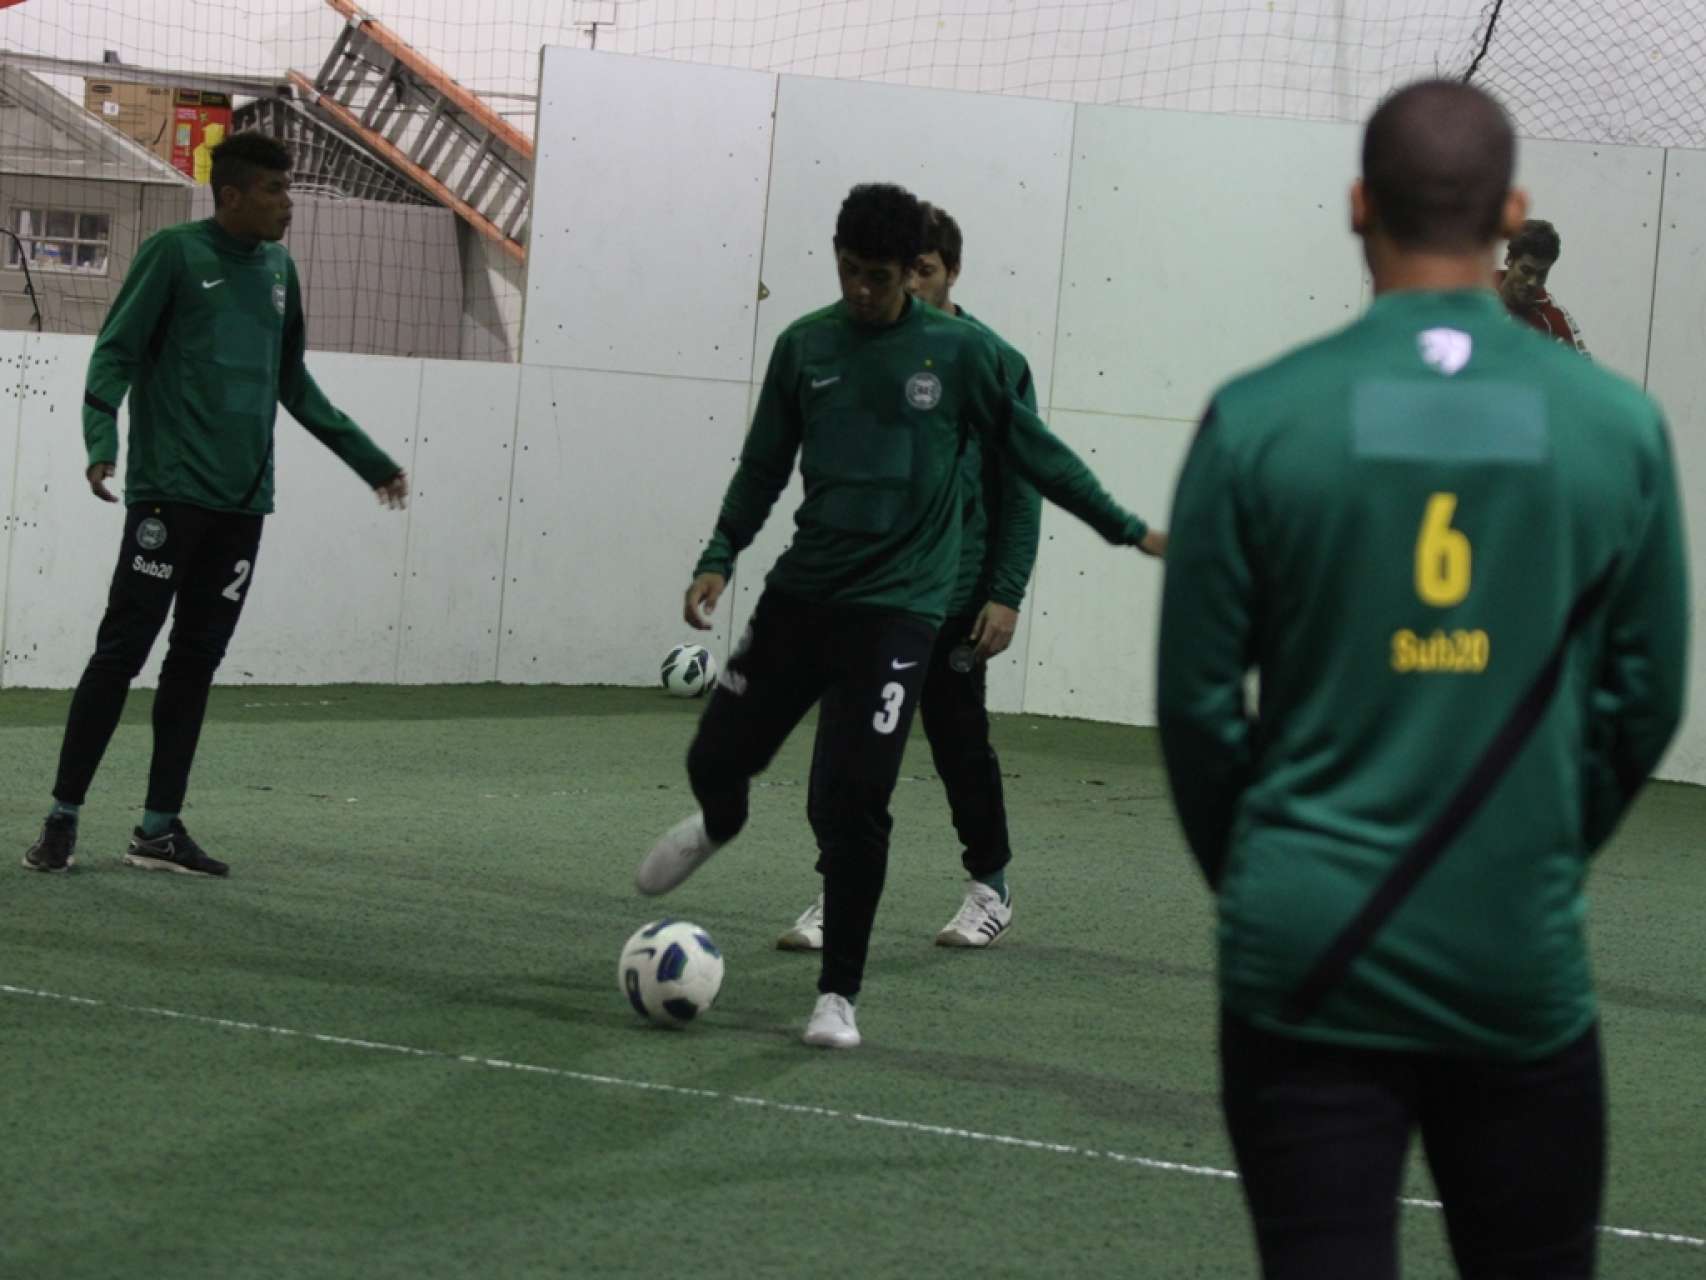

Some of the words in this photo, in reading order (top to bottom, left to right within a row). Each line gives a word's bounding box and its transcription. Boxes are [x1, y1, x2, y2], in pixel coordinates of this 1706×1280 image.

[132, 554, 173, 580] Sub20
[1414, 491, 1472, 608] 6
[221, 559, 250, 602] 2
[1391, 628, 1490, 673] Sub20
[872, 681, 905, 735] 3
